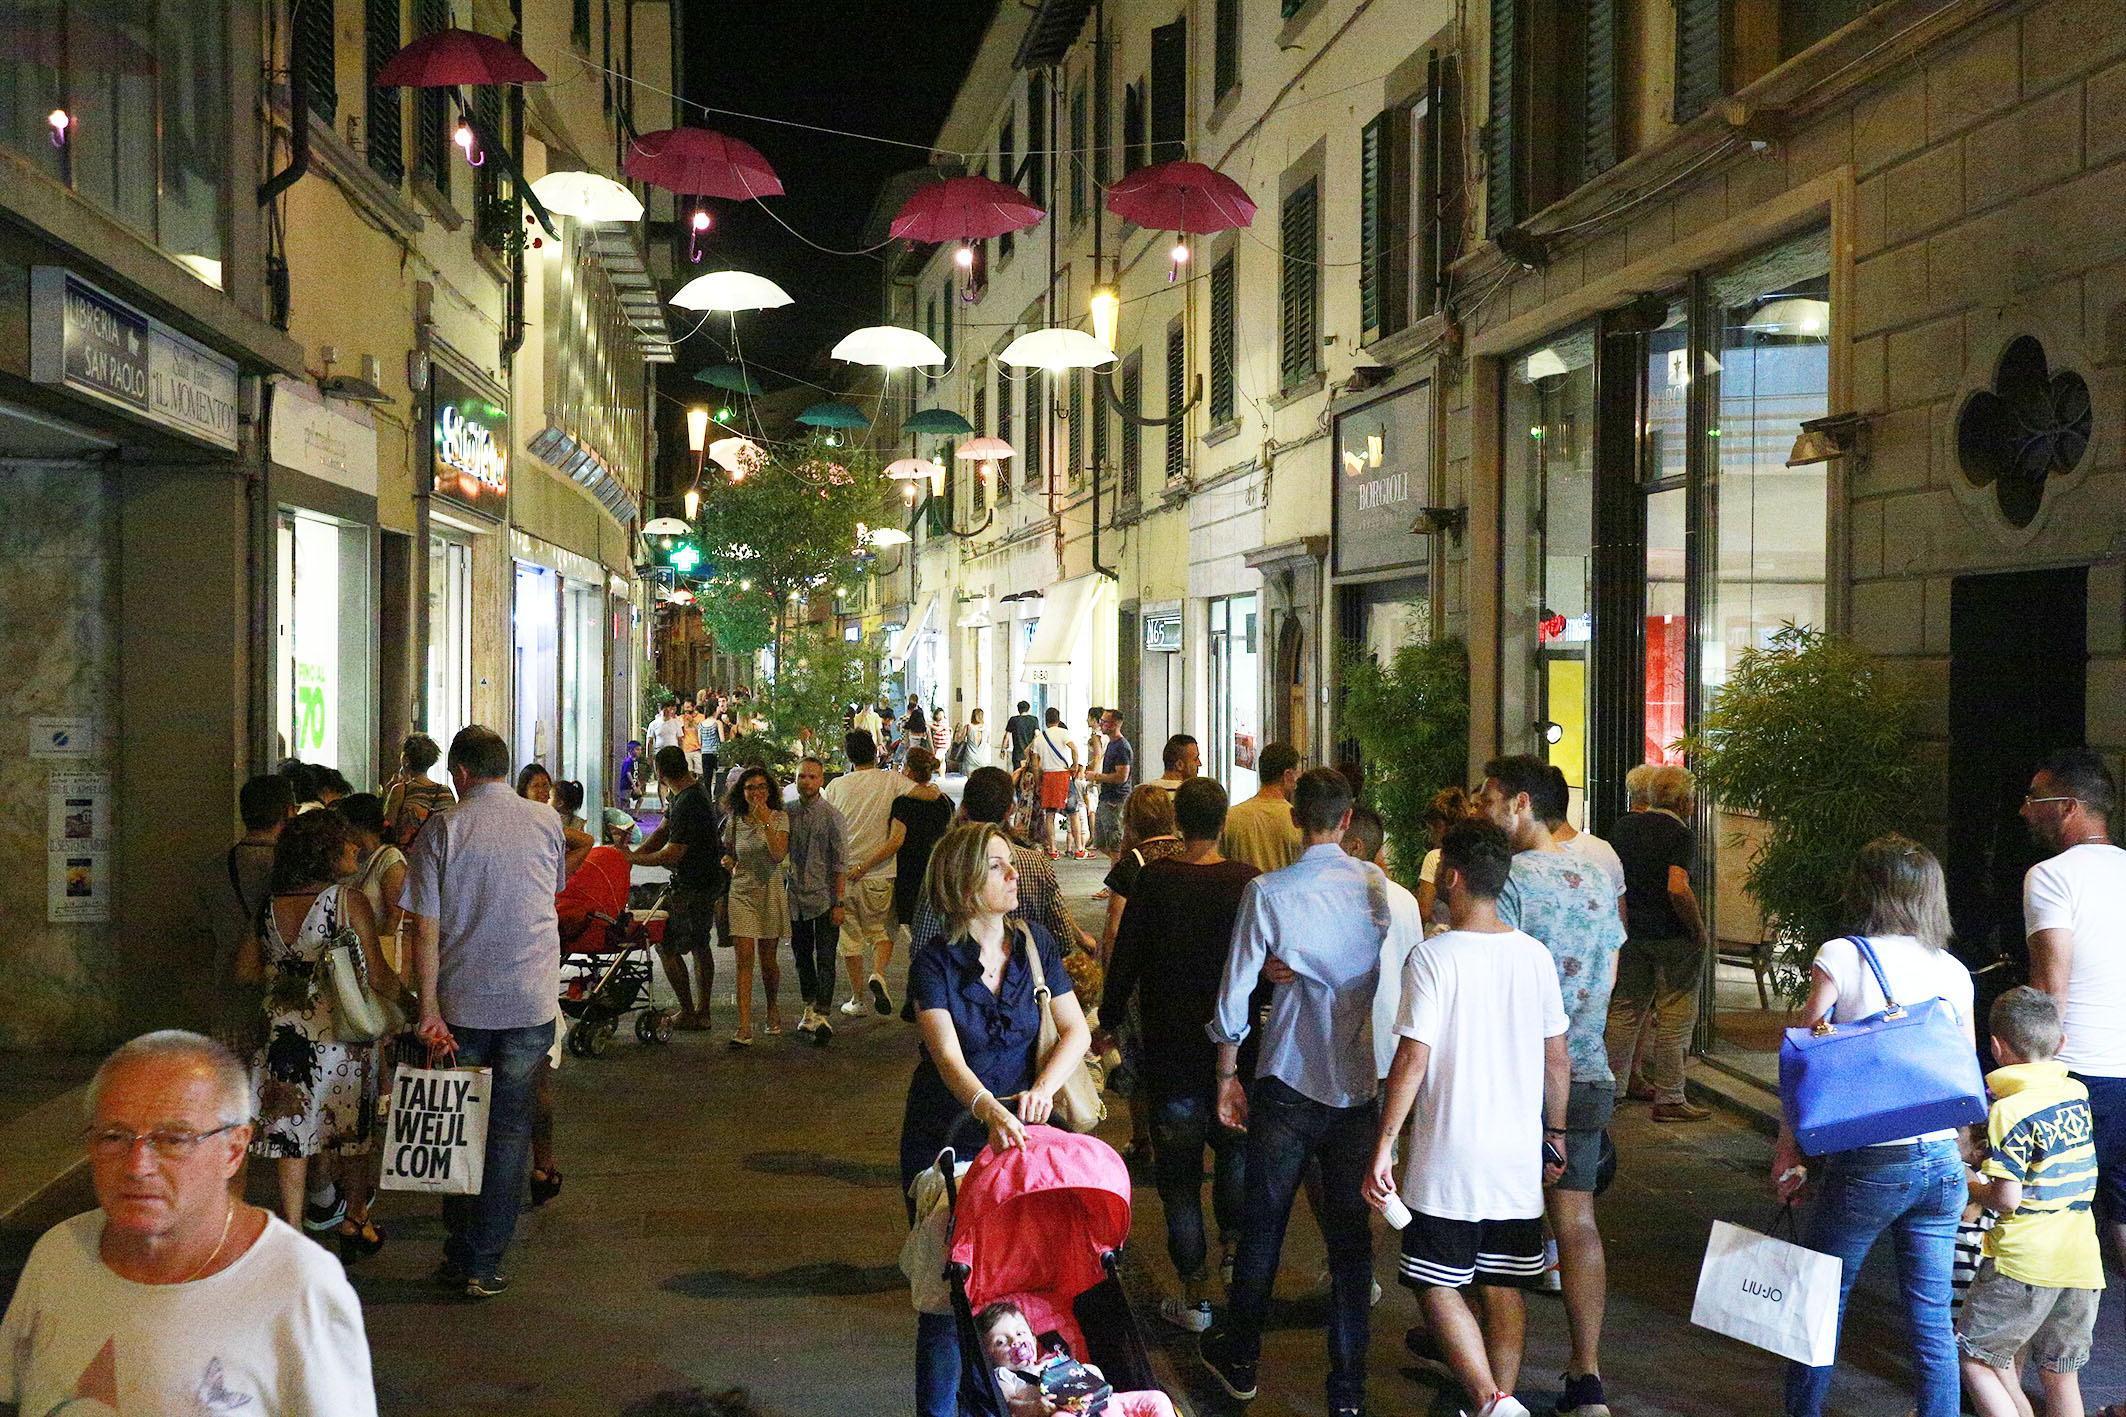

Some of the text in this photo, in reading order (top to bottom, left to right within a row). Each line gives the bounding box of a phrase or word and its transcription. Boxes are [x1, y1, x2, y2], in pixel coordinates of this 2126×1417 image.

[66, 290, 120, 347] LIBRERIA
[85, 344, 146, 399] SAN PAOLO
[1358, 471, 1408, 511] BORGIOLI
[386, 1144, 452, 1180] .COM
